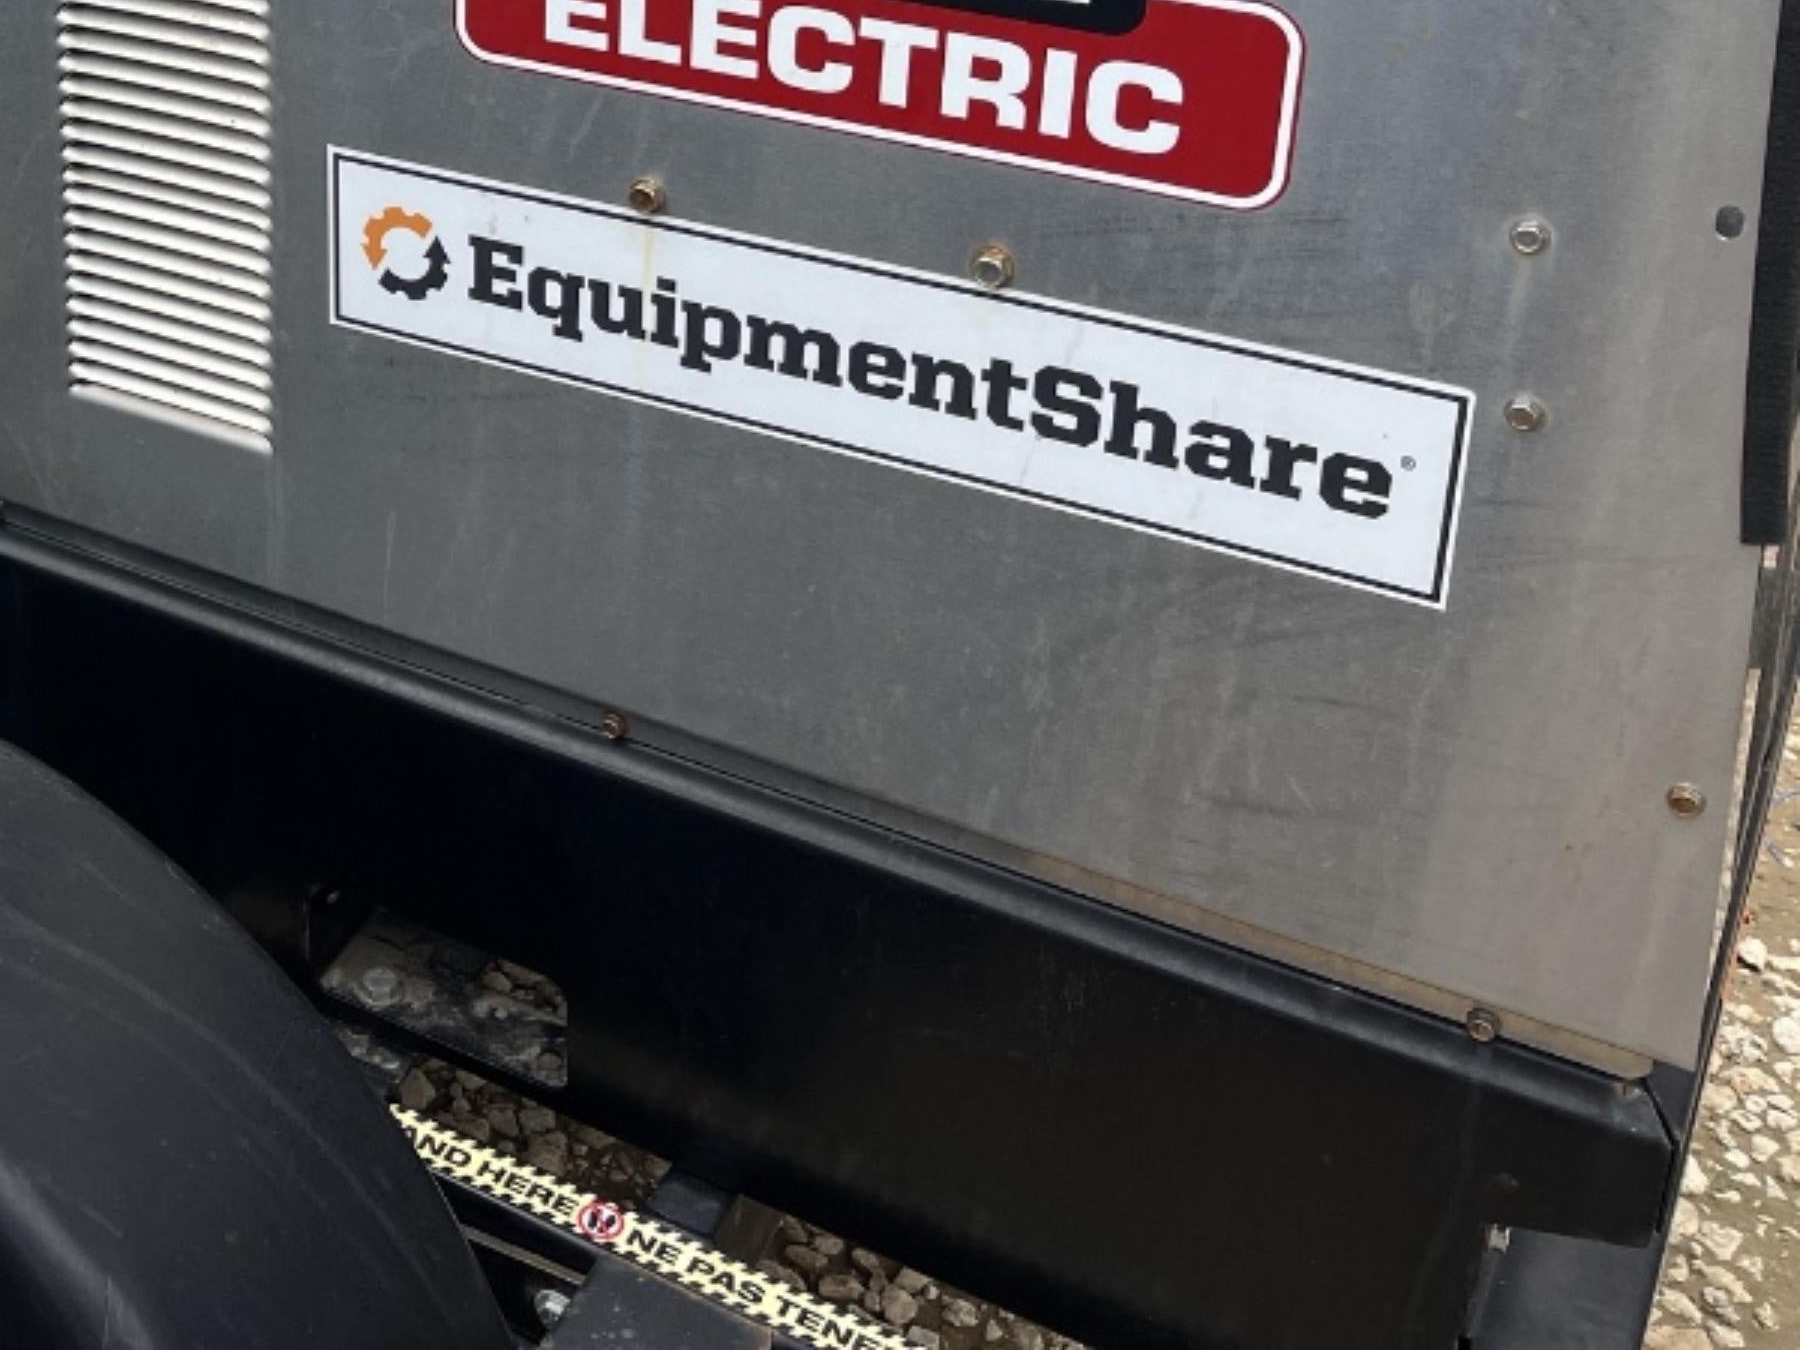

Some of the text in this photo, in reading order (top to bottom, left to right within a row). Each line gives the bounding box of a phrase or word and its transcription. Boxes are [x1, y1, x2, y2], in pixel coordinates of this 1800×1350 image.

[466, 234, 1393, 519] EquipmentShare
[477, 1160, 580, 1217] HERE
[626, 1228, 683, 1265] NE
